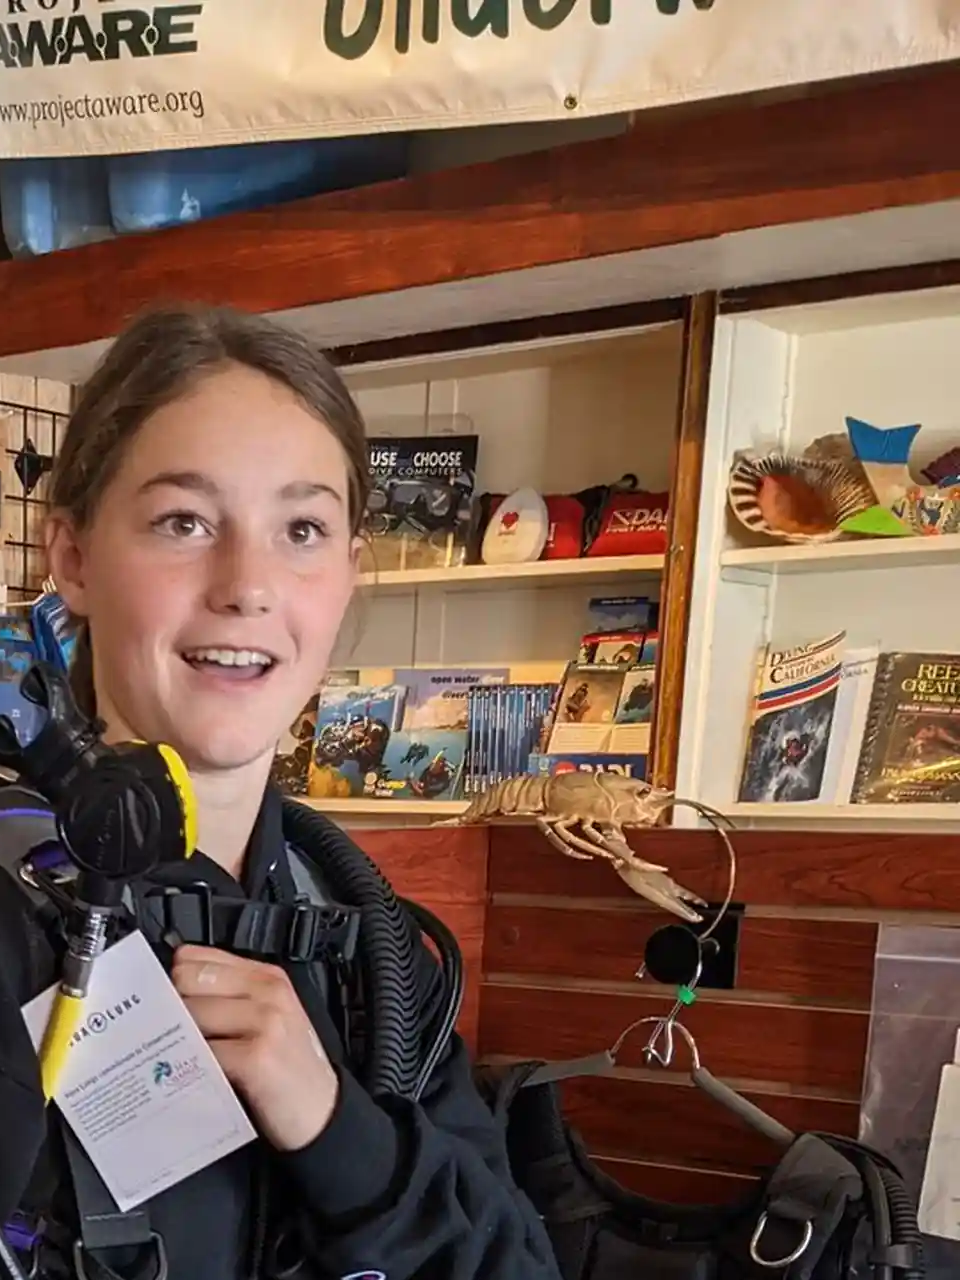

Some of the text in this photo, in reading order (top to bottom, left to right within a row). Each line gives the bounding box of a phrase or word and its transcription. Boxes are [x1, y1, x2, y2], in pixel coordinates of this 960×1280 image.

[369, 451, 463, 467] USE CHOOSE
[106, 993, 142, 1021] LUNG
